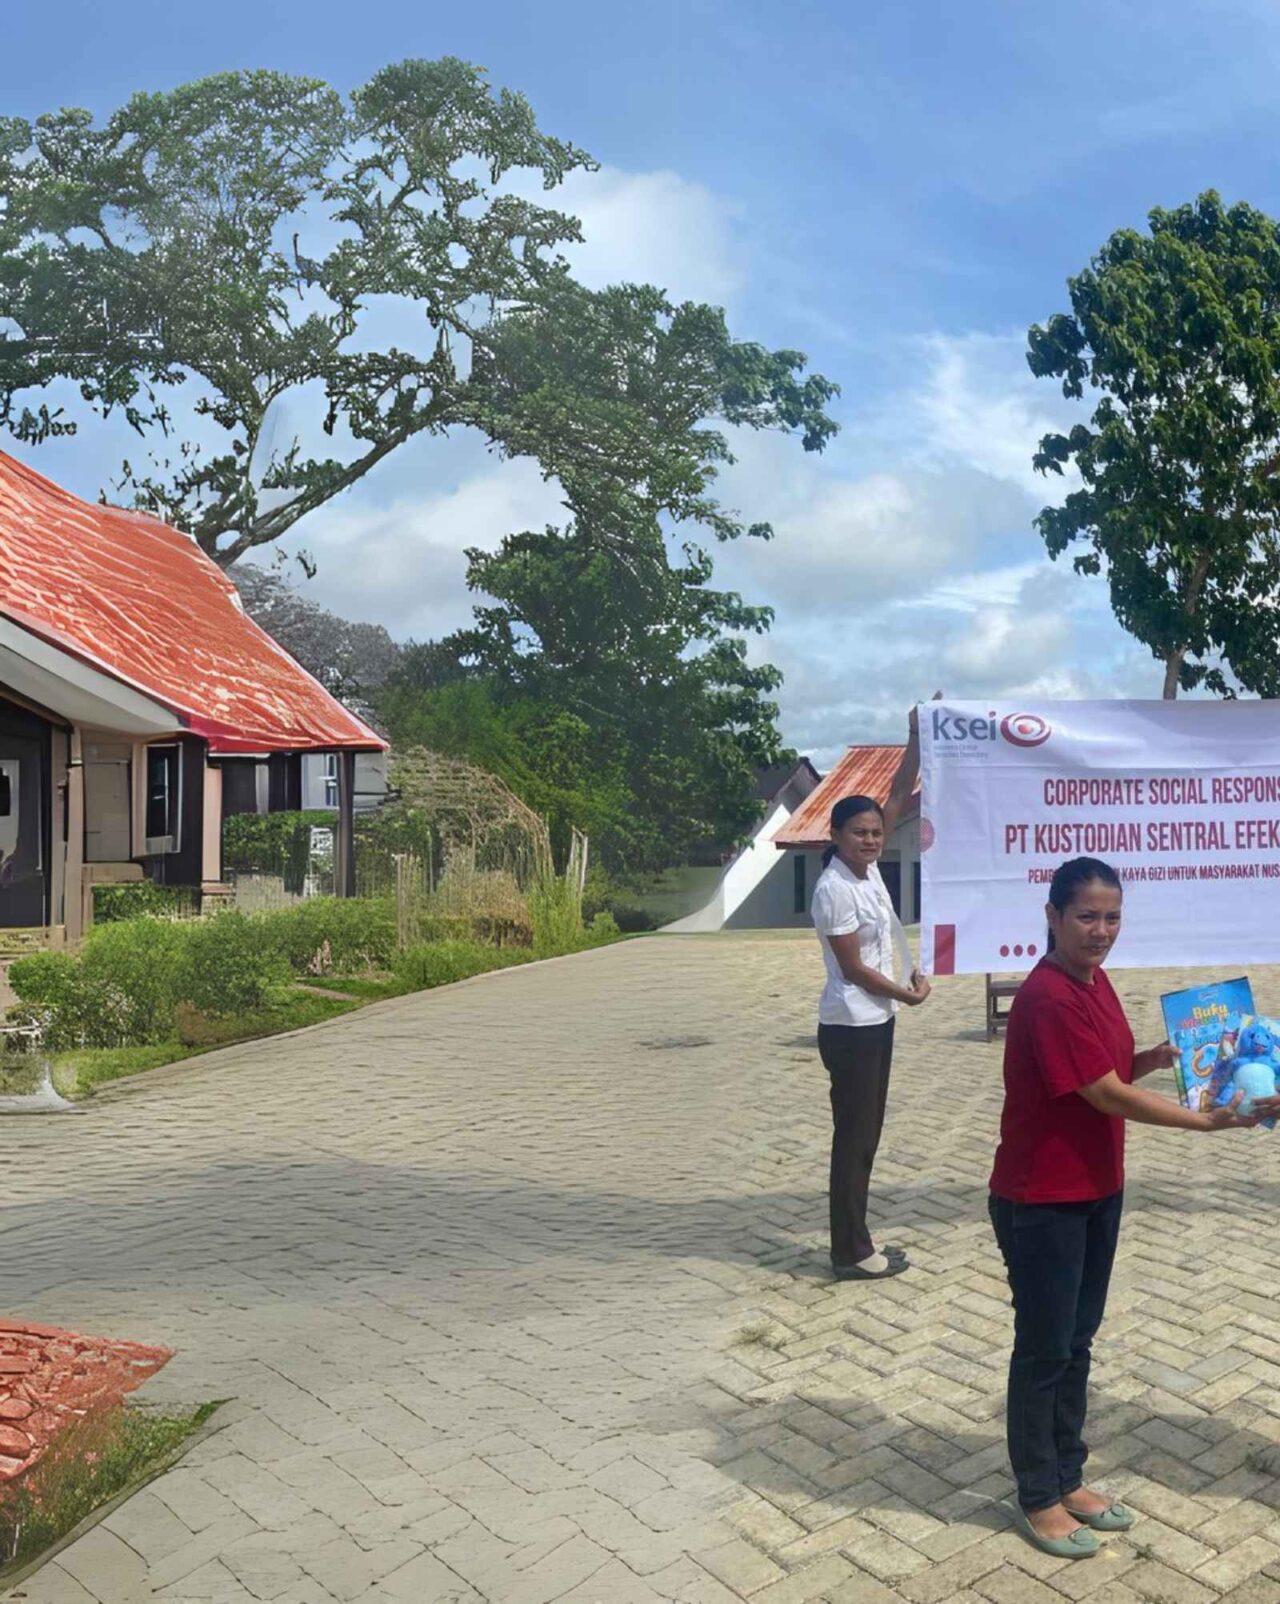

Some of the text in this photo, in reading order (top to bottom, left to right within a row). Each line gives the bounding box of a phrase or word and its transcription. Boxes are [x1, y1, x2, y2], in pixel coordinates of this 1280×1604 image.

[932, 708, 996, 741] ksei
[1044, 778, 1144, 806] CORPORATE
[1149, 777, 1208, 805] SOCIAL
[1005, 824, 1029, 854] PT
[1035, 823, 1141, 854] KUSTODIAN
[1147, 820, 1230, 852] SENTRAL
[1235, 819, 1280, 849] EFEK
[1121, 867, 1147, 882] KAYA
[1148, 866, 1165, 881] GIZI
[1167, 865, 1196, 880] UNTUK
[1200, 863, 1259, 880] MASYARAKAT
